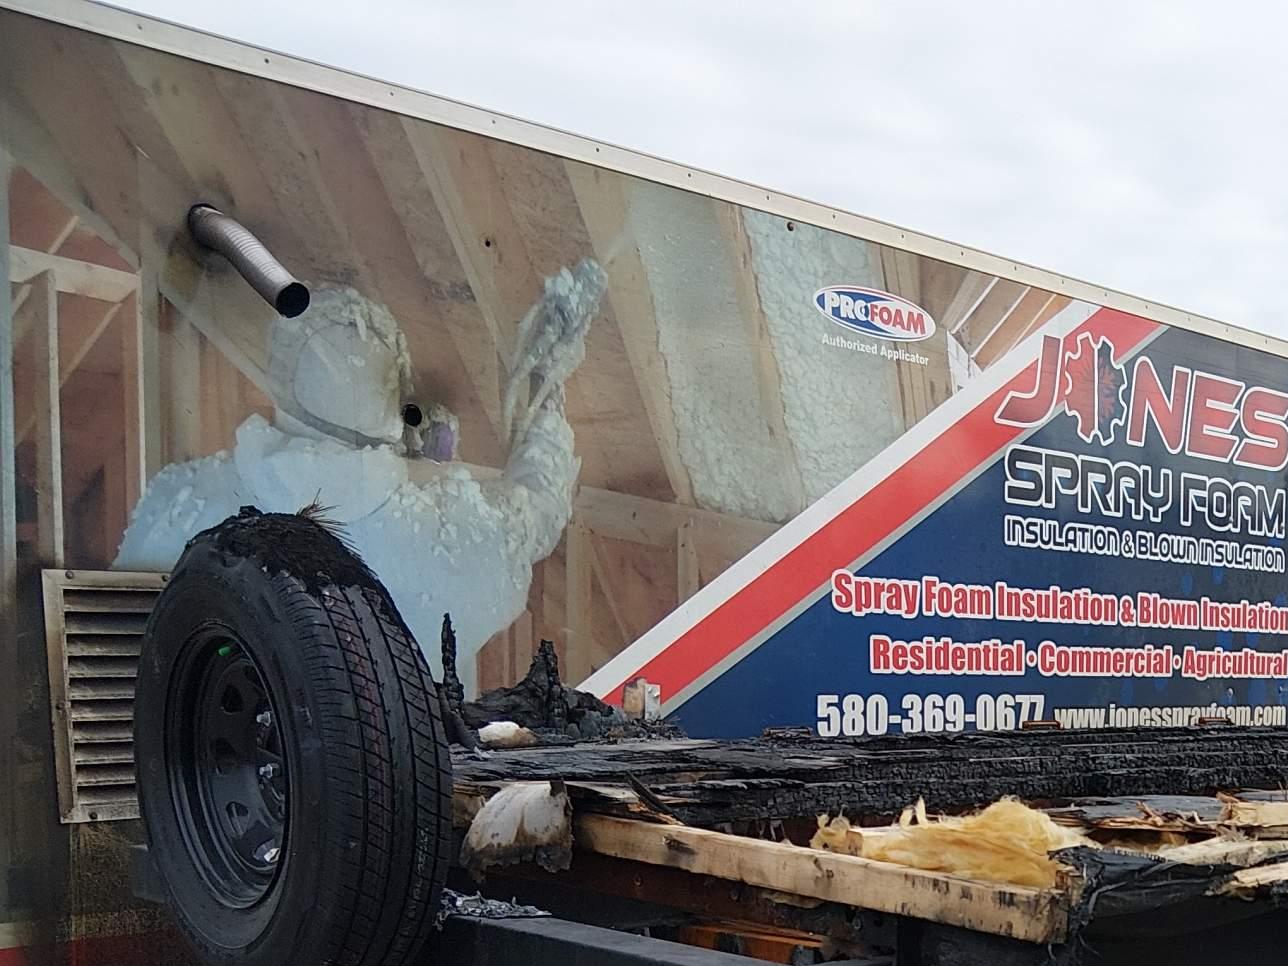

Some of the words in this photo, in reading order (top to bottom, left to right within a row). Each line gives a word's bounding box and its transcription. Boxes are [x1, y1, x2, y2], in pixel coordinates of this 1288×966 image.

[824, 290, 926, 335] PROFOAM
[821, 333, 878, 355] Authorized
[879, 344, 930, 366] Applicator
[1004, 443, 1172, 522] SPRAY
[1180, 472, 1286, 539] FOAM
[1121, 529, 1135, 559] &
[832, 569, 919, 619] Spray
[922, 576, 994, 619] Foam
[995, 582, 1118, 626] Insulation
[1119, 595, 1136, 627] &
[1137, 592, 1200, 630] Blown
[870, 634, 1025, 676] Residential
[1038, 641, 1173, 678] Commercial
[1182, 646, 1288, 681] Agricultural
[817, 693, 1045, 737] 580-369-0677
